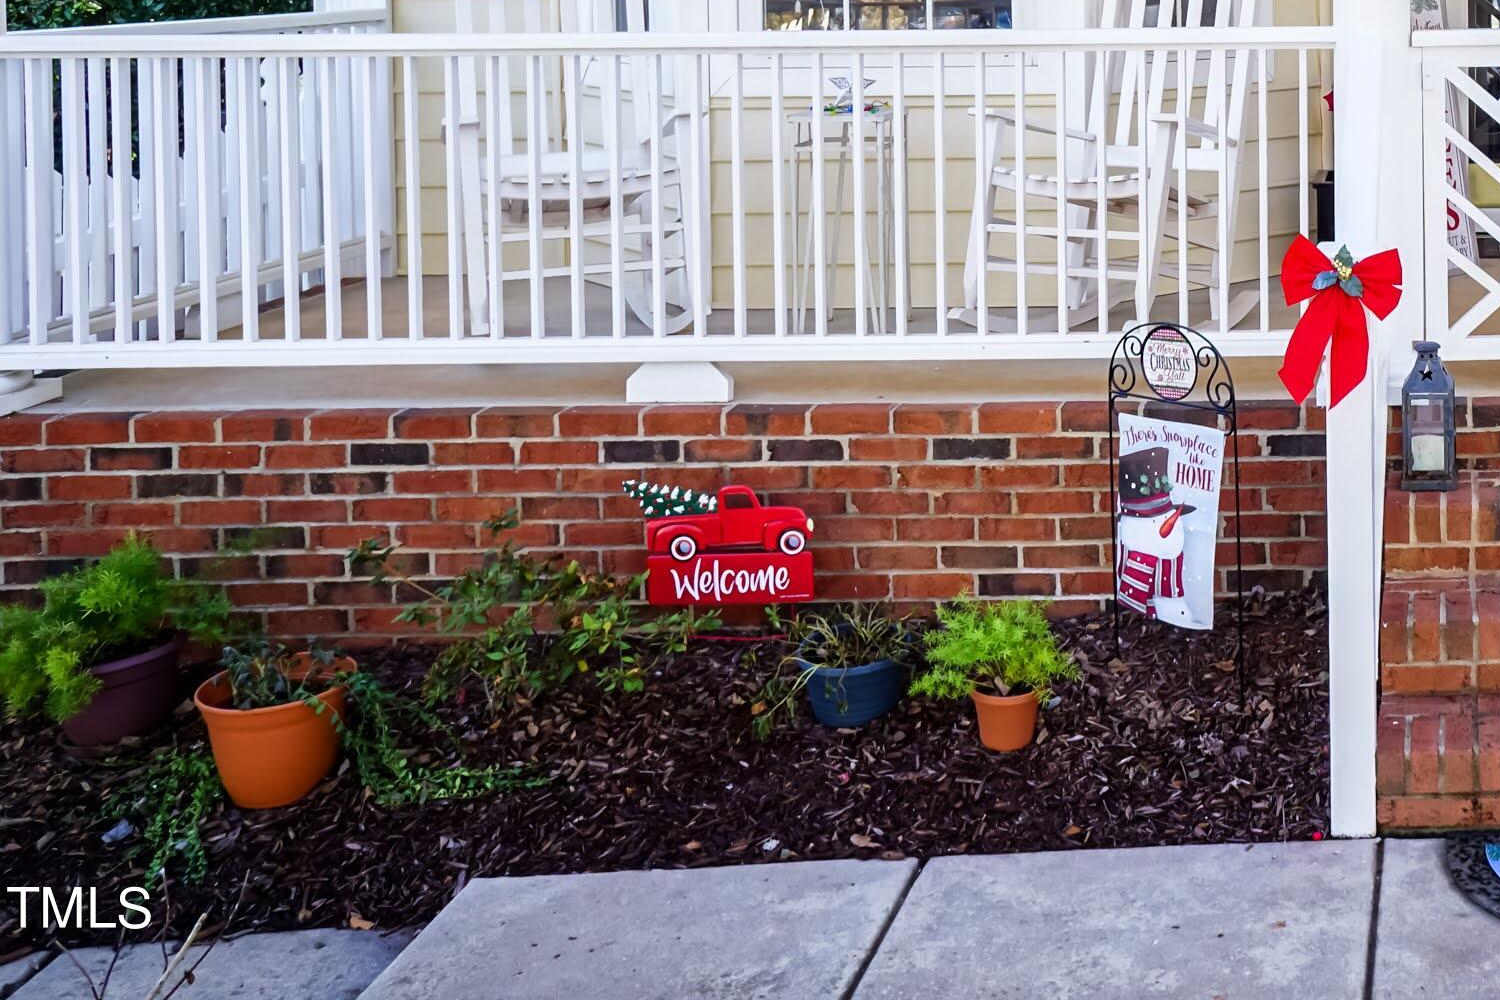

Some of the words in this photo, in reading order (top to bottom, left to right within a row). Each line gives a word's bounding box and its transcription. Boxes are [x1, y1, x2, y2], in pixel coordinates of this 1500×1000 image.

[1153, 343, 1181, 358] Merry
[1161, 425, 1218, 458] Snowplace
[1189, 452, 1206, 466] like
[1175, 462, 1216, 493] HOME
[670, 557, 790, 601] Welcome
